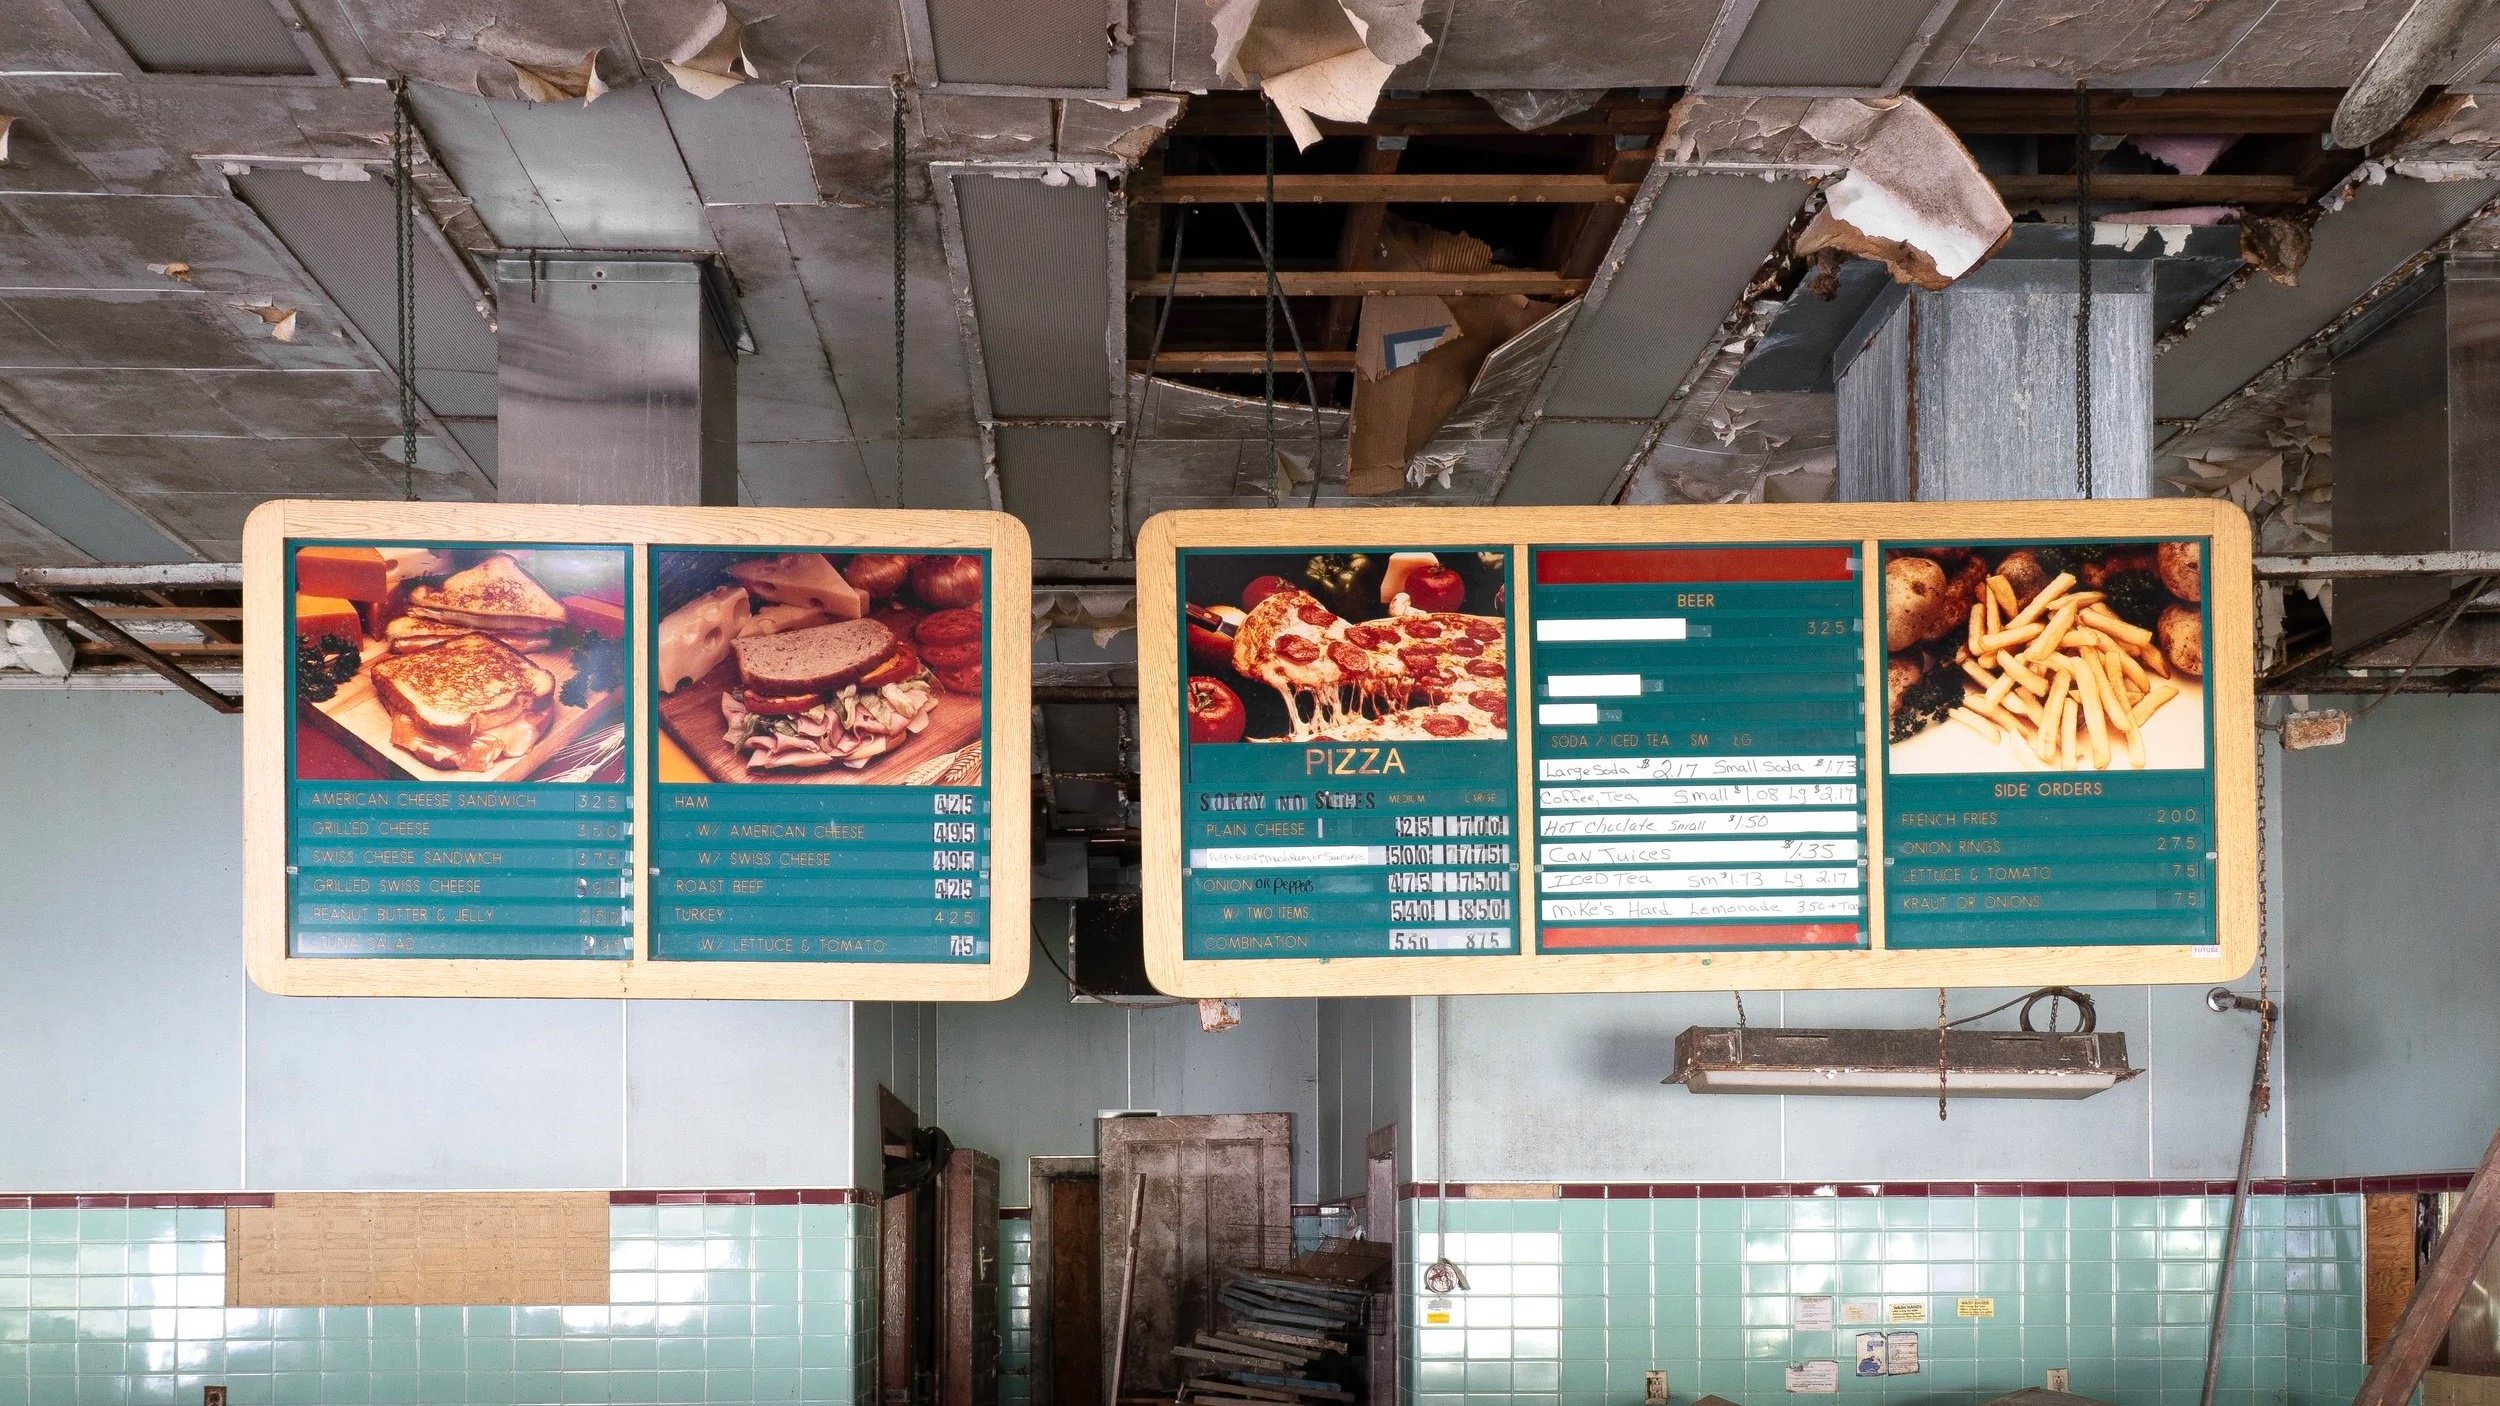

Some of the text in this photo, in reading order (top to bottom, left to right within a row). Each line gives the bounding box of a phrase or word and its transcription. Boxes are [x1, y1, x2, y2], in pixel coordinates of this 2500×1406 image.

[1678, 593, 1715, 608] BEER
[1808, 621, 1845, 635] 325
[1551, 734, 1588, 748] SODA
[1610, 734, 1638, 748] ICED
[1647, 734, 1669, 747] TEA
[1690, 734, 1708, 746] SM
[1733, 734, 1751, 747] LG
[1305, 748, 1406, 775] PIZZA
[1547, 762, 1590, 780] Large
[1593, 762, 1630, 776] Soda
[1712, 759, 1758, 776] Small
[1763, 761, 1804, 773] Soda
[1674, 787, 1729, 804] Small
[1994, 782, 2102, 797] SIDE ORDERS
[311, 792, 617, 808] AMERICAN CHEESE SANDWICH 325
[675, 795, 972, 814] HAM 425
[1200, 792, 1265, 811] SORRY
[1278, 794, 1306, 810] NO
[1389, 794, 1496, 803] MEDIUM LARGE
[1668, 820, 1706, 832] Small
[1902, 809, 2195, 826] FRENCH FRIES 200
[312, 822, 617, 838] GRILLED CHEESE 350
[697, 823, 973, 842] W/ AMERICAN CHEESE 495
[1207, 823, 1246, 836] PLAIN
[1254, 823, 1305, 836] CHEESE
[1462, 817, 1499, 836] 700
[1598, 848, 1672, 863] Juices
[1784, 840, 1835, 859] $1.35
[1902, 836, 2195, 855] ONION RINGS 275
[312, 850, 354, 863] SWISS
[362, 850, 415, 864] CHEESE
[423, 851, 502, 865] SANDWICH
[698, 851, 973, 870] W/ SWISS CHEESE 495
[1391, 847, 1428, 864] 500
[1614, 873, 1652, 886] Tea
[1816, 871, 1846, 884] 2.17
[1903, 865, 2196, 882] LETTUCE & TOMATO 75
[312, 879, 369, 892] GRILLED
[380, 879, 420, 892] SWISS
[429, 880, 481, 893] CHEESE
[676, 879, 972, 899] ROAST BEEF 425
[1203, 879, 1253, 891] ONION
[1391, 874, 1429, 892] 475
[1462, 875, 1498, 891] 750
[1629, 901, 1673, 917] Hard
[1690, 902, 1779, 915] Lemonade
[1903, 893, 2197, 910] KRAUT OR ONIONS 75
[313, 908, 368, 921] PEANUT
[377, 908, 427, 921] BUTTER
[455, 908, 494, 922] JELLY
[674, 909, 973, 924] TURKEY 425
[1223, 901, 1500, 921] W/ TWO ITEMS 540 850
[320, 936, 415, 950] TUNA SALAD
[700, 936, 972, 955] W/ LETTUCE & TOMATO 75
[1204, 932, 1499, 950] COMBINATION 550 875
